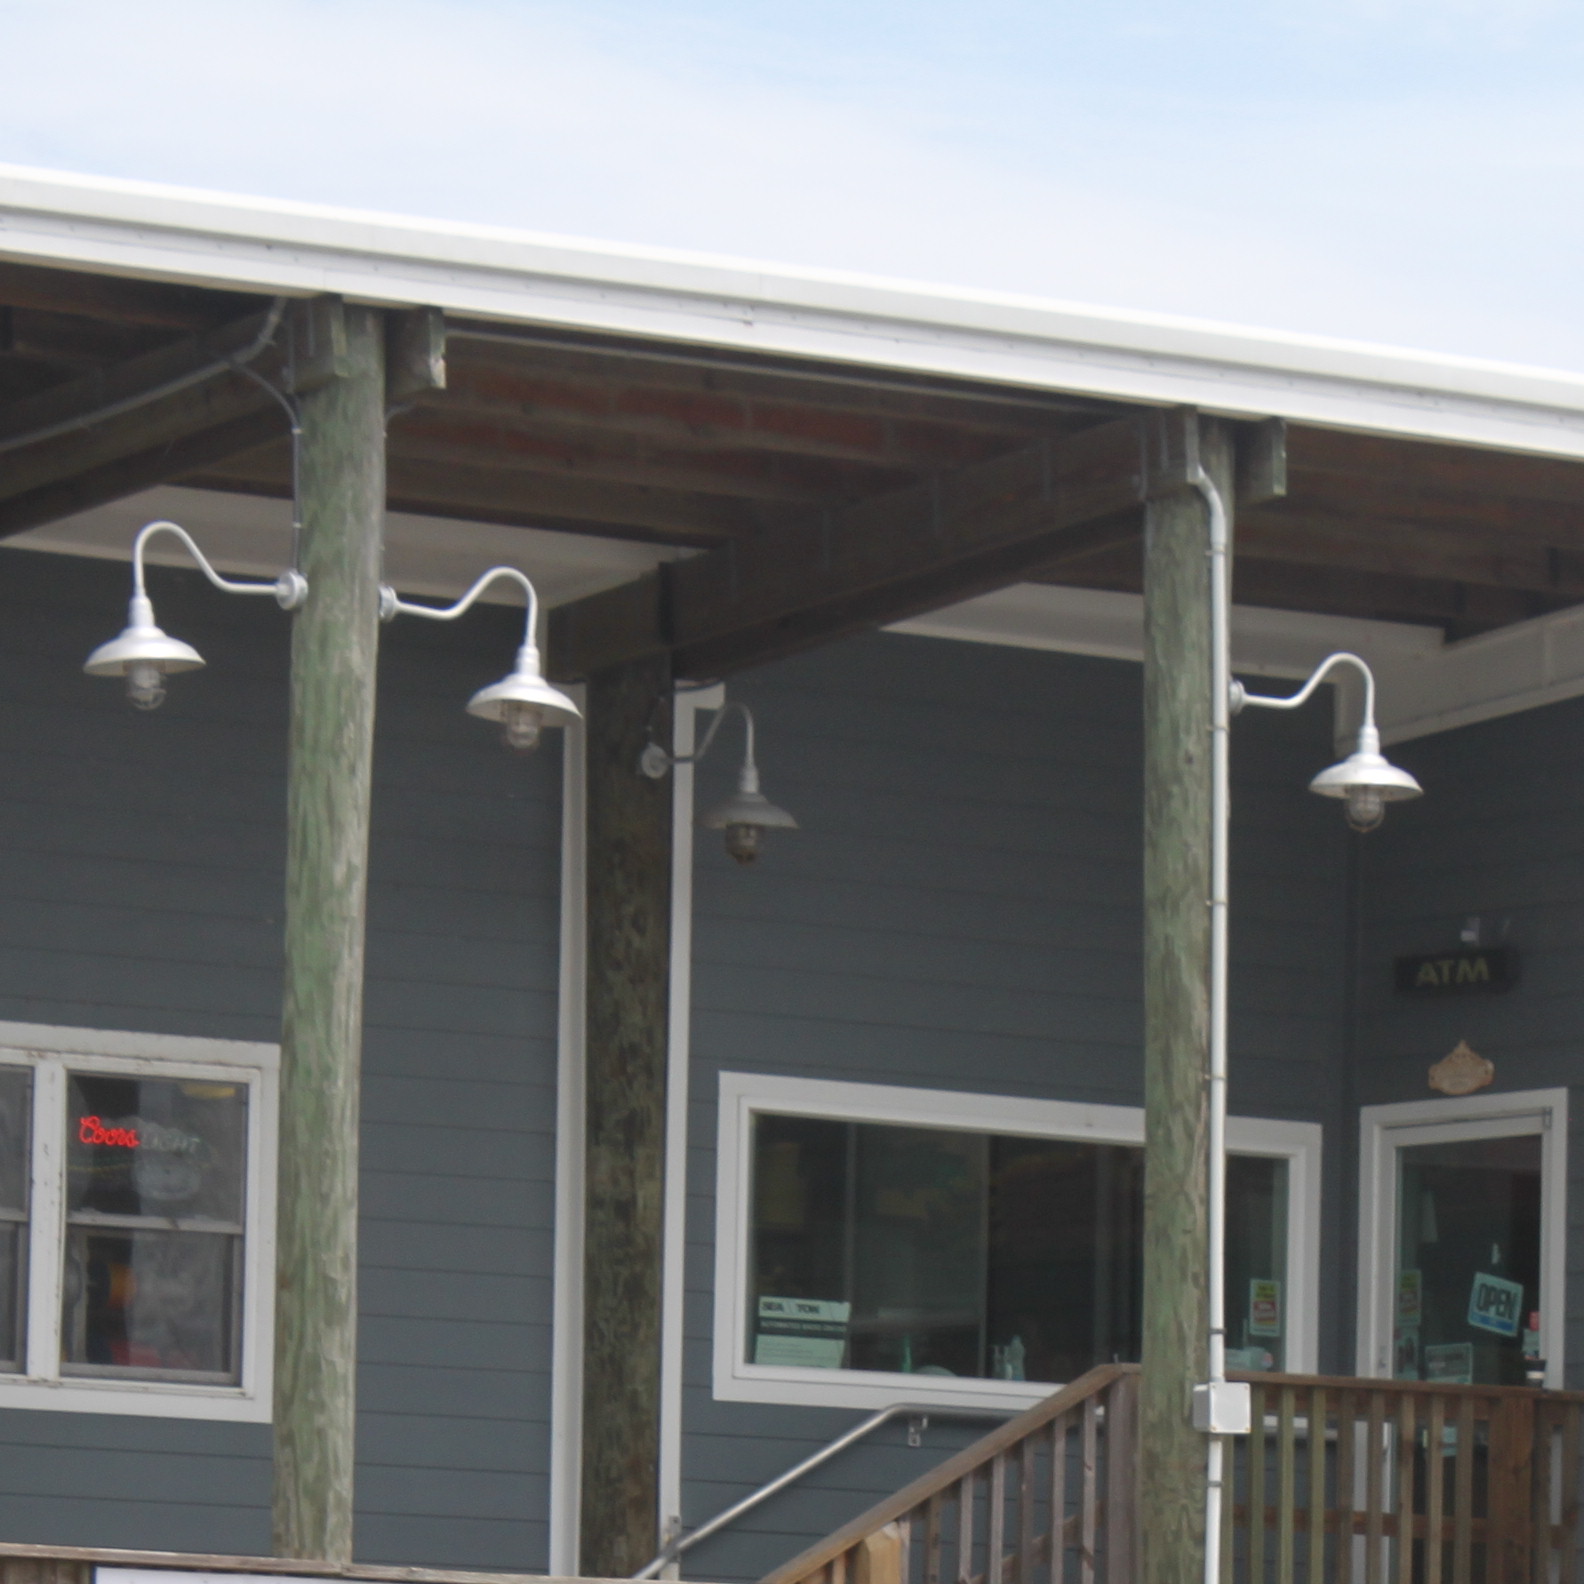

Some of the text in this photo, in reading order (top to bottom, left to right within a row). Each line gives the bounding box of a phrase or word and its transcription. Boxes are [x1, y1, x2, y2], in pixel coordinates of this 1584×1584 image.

[1417, 957, 1489, 985] ATM
[79, 1115, 141, 1148] Coors
[1477, 1283, 1515, 1319] OPEN
